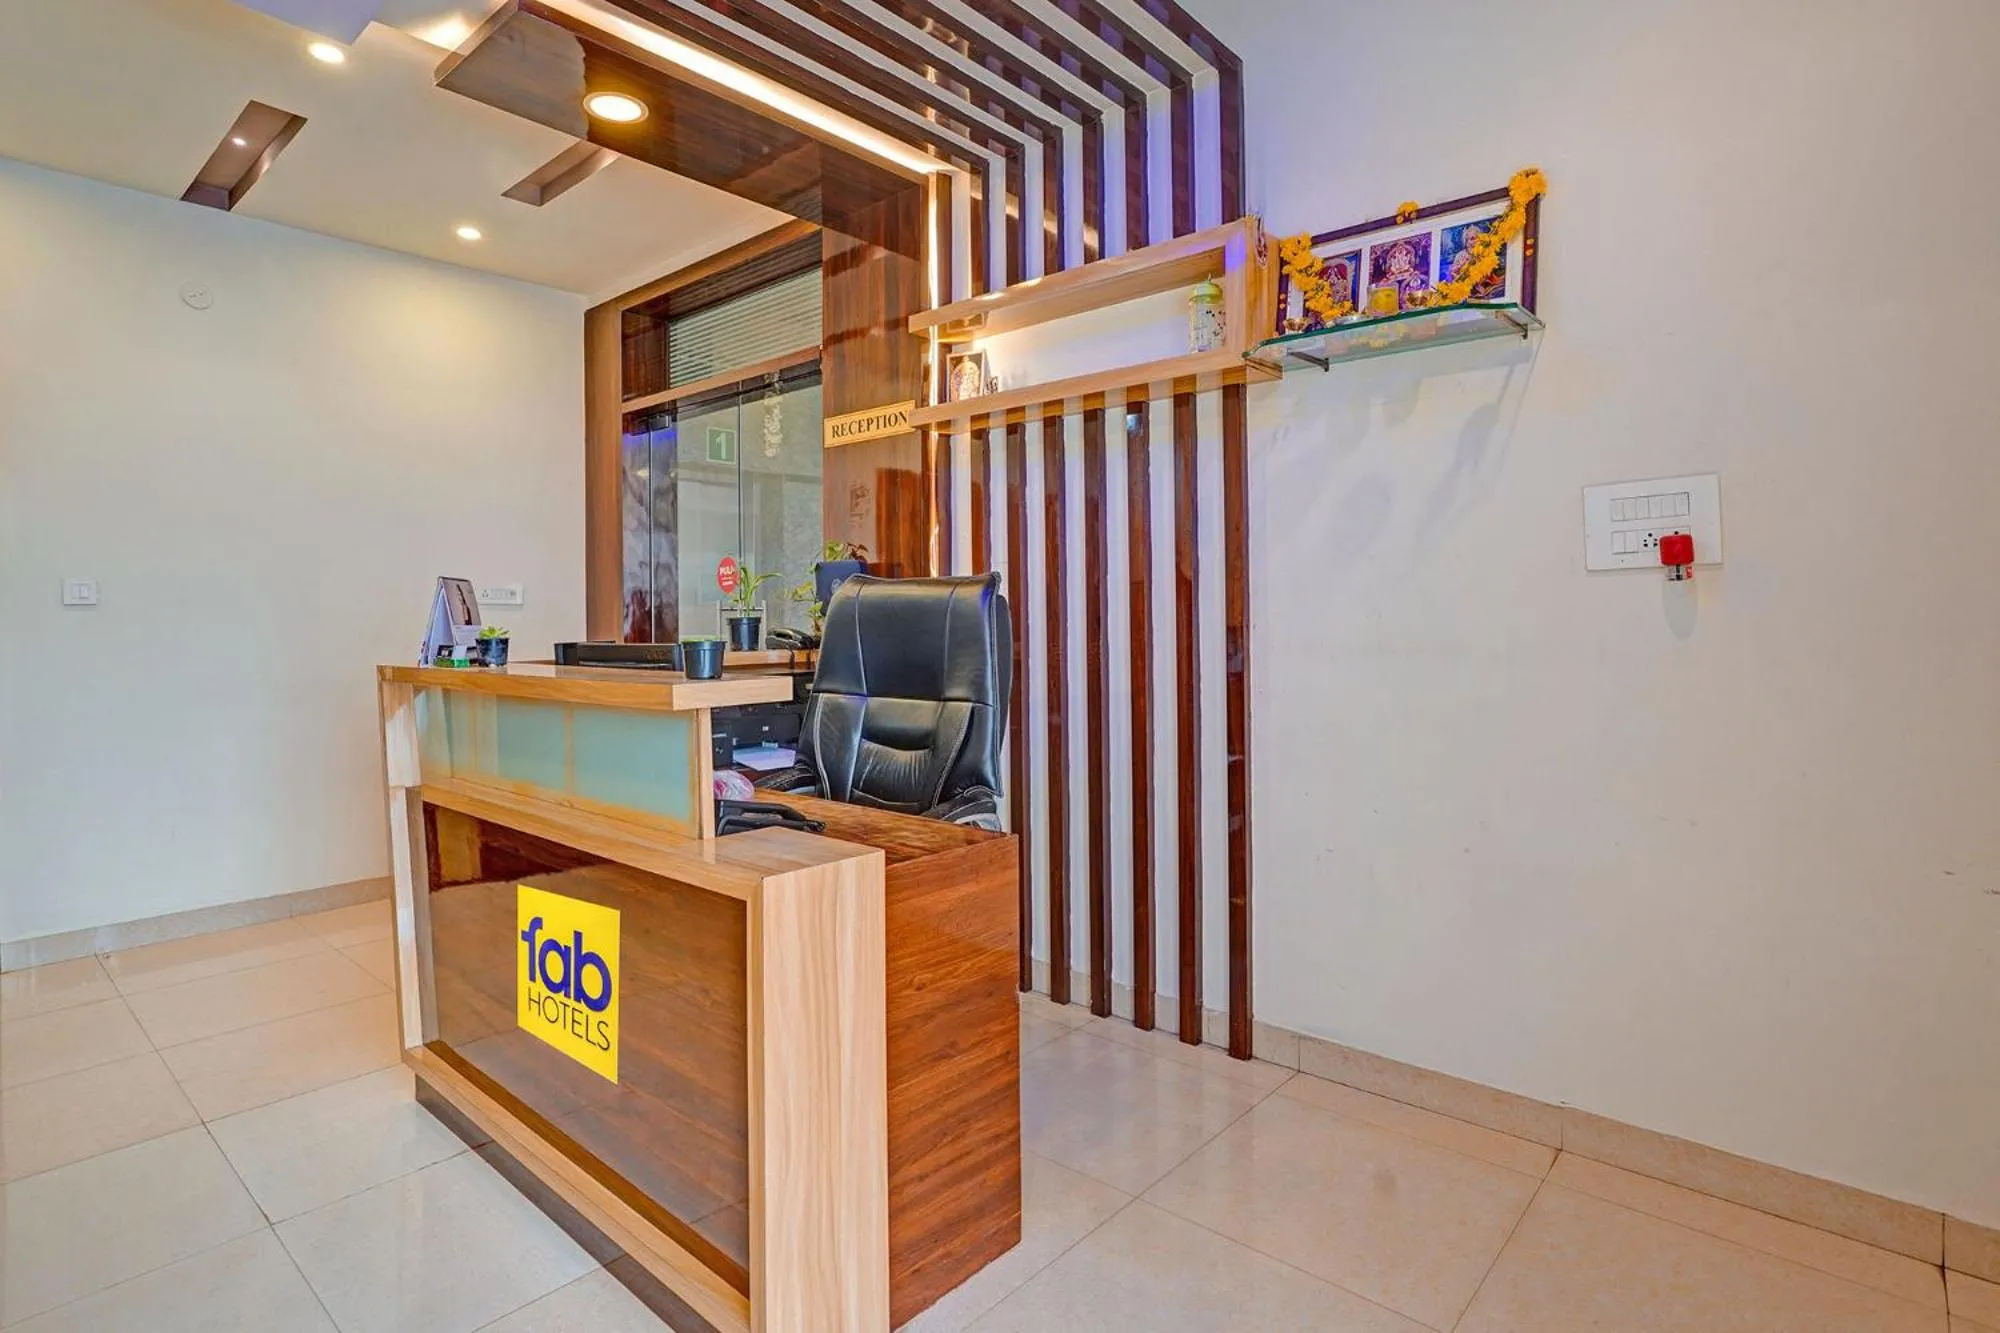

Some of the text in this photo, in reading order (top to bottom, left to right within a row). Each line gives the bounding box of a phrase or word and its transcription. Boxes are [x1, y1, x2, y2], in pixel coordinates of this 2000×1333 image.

[832, 410, 907, 438] RECEPTION
[521, 917, 612, 1012] fab
[528, 987, 610, 1051] HOTELS
